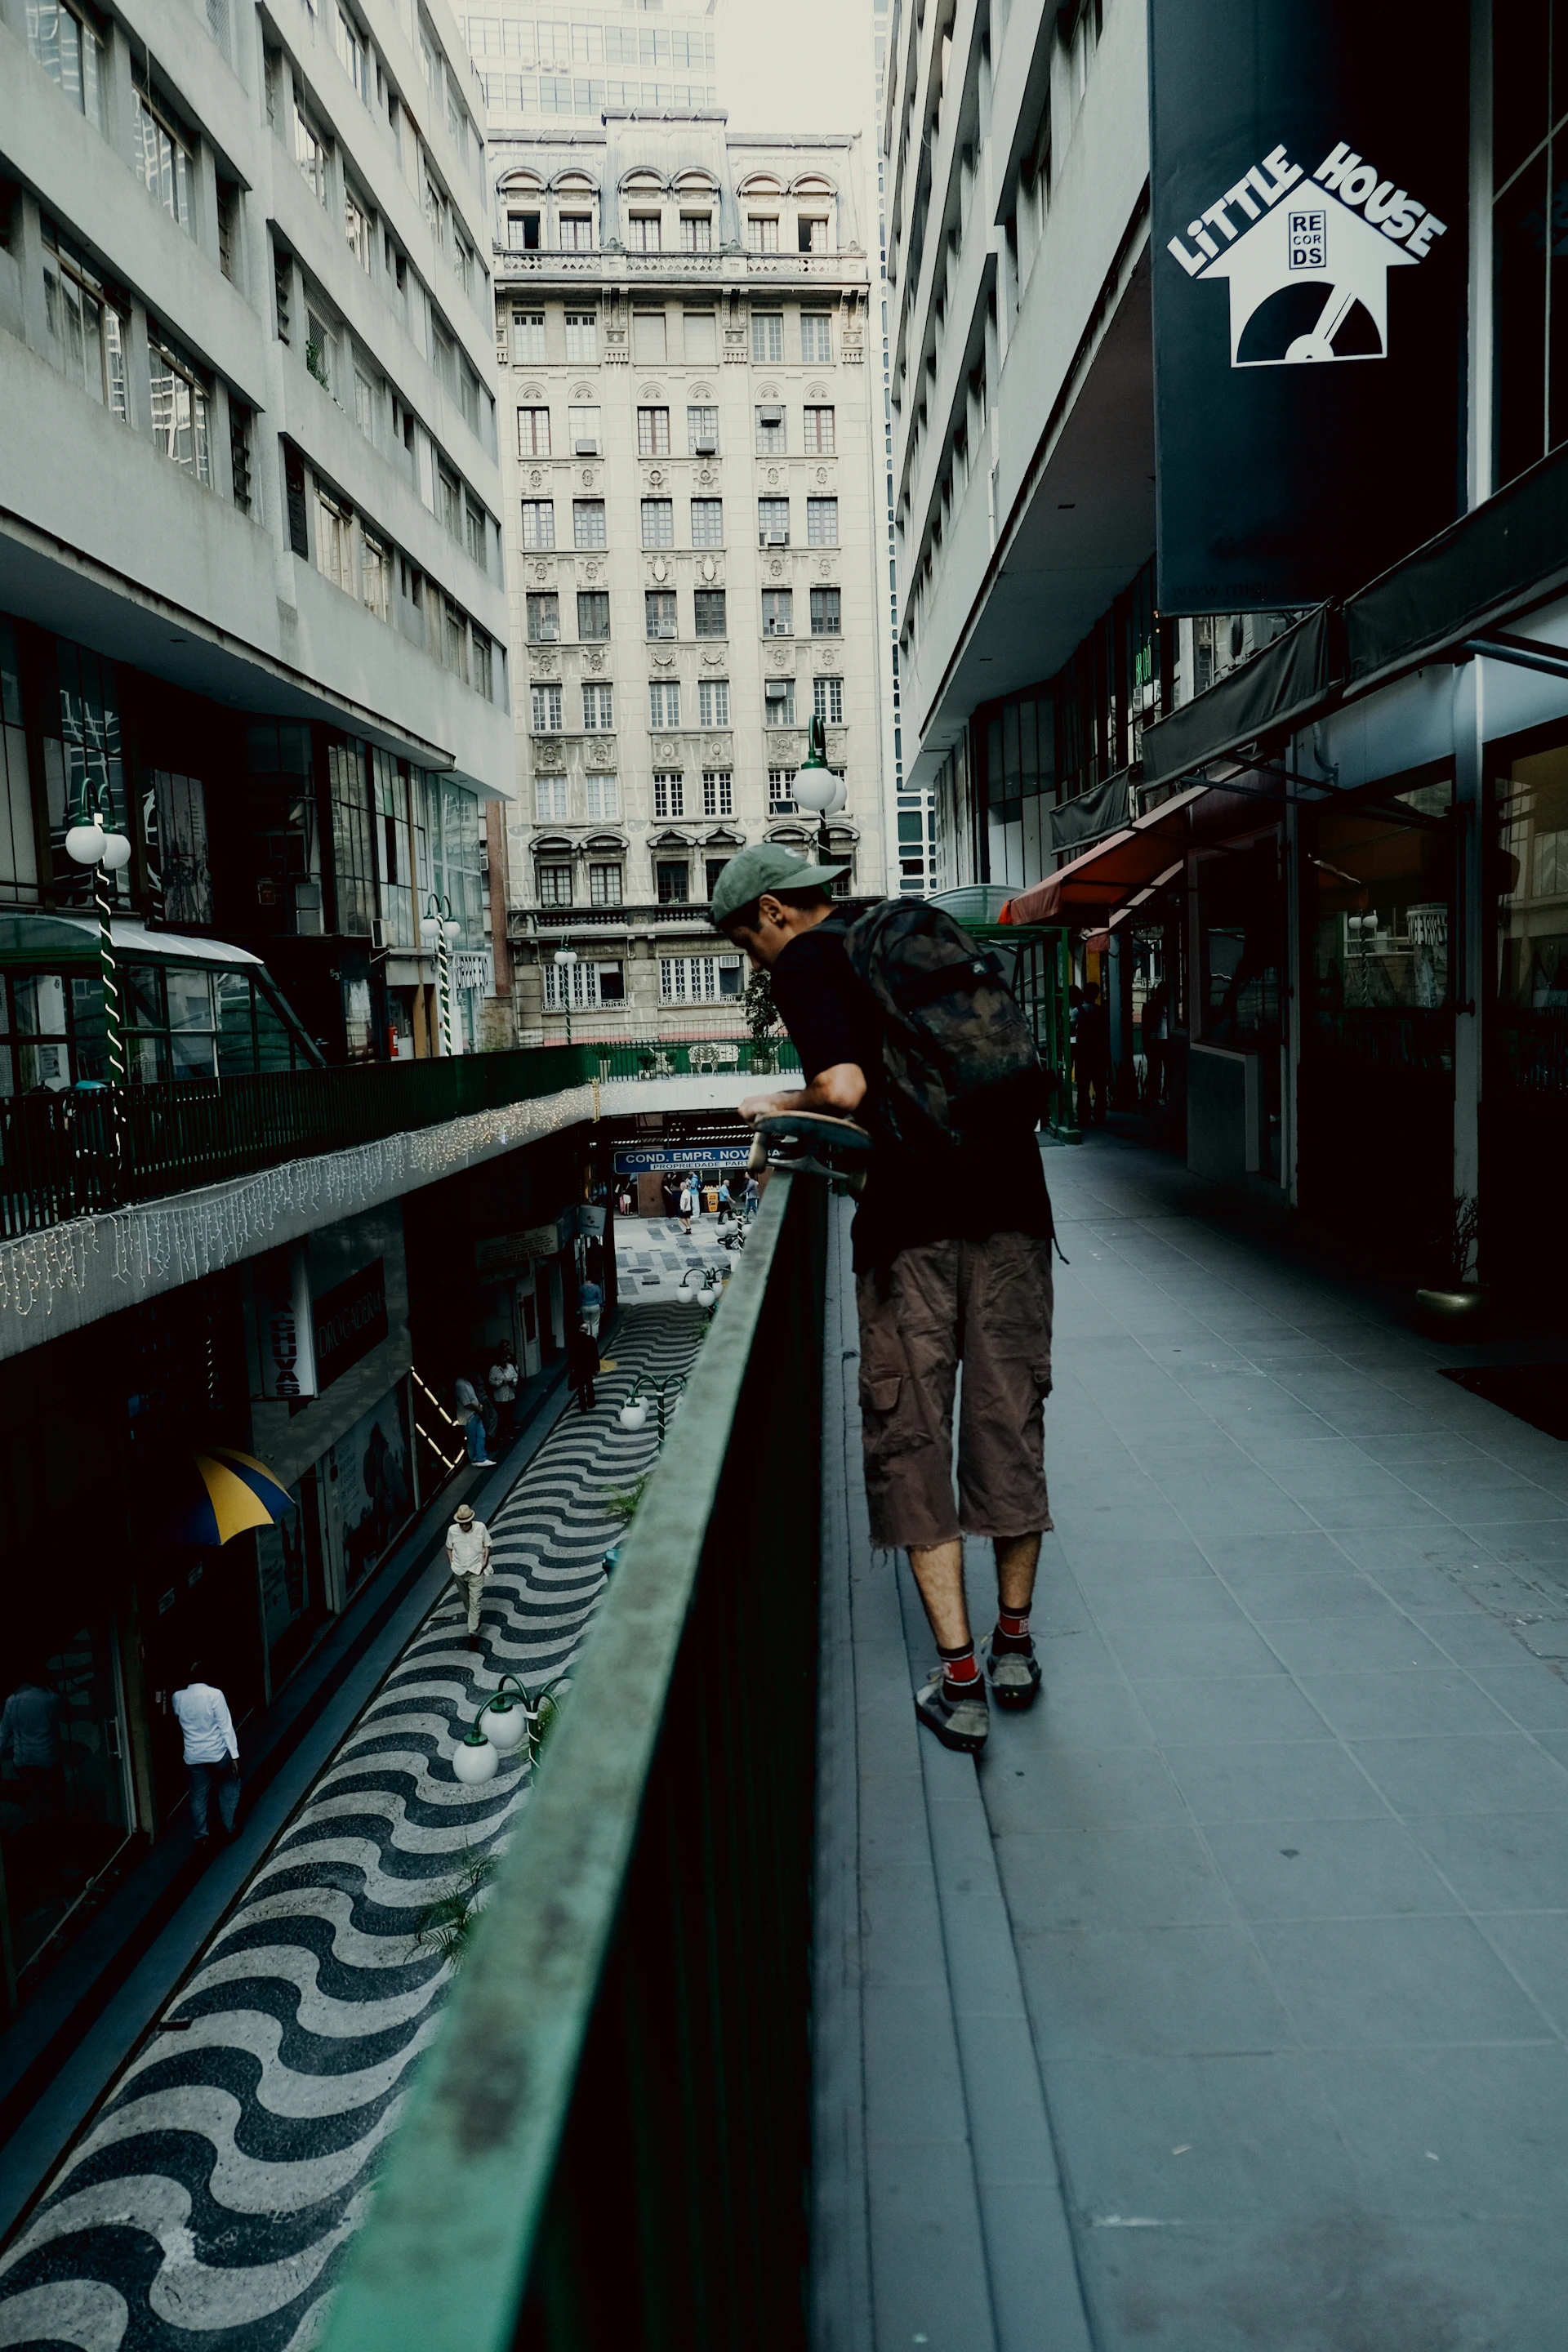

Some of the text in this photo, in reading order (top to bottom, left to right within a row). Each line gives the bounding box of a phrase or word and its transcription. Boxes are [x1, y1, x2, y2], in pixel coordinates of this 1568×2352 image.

[1312, 140, 1449, 258] HOUSE
[1293, 215, 1322, 232] RE
[1293, 234, 1321, 245] COR
[1293, 247, 1322, 265] DS
[329, 968, 341, 981] 53
[626, 1152, 670, 1165] COND.
[673, 1150, 716, 1162] EMPR.
[653, 1161, 720, 1170] PROPRIEDADE
